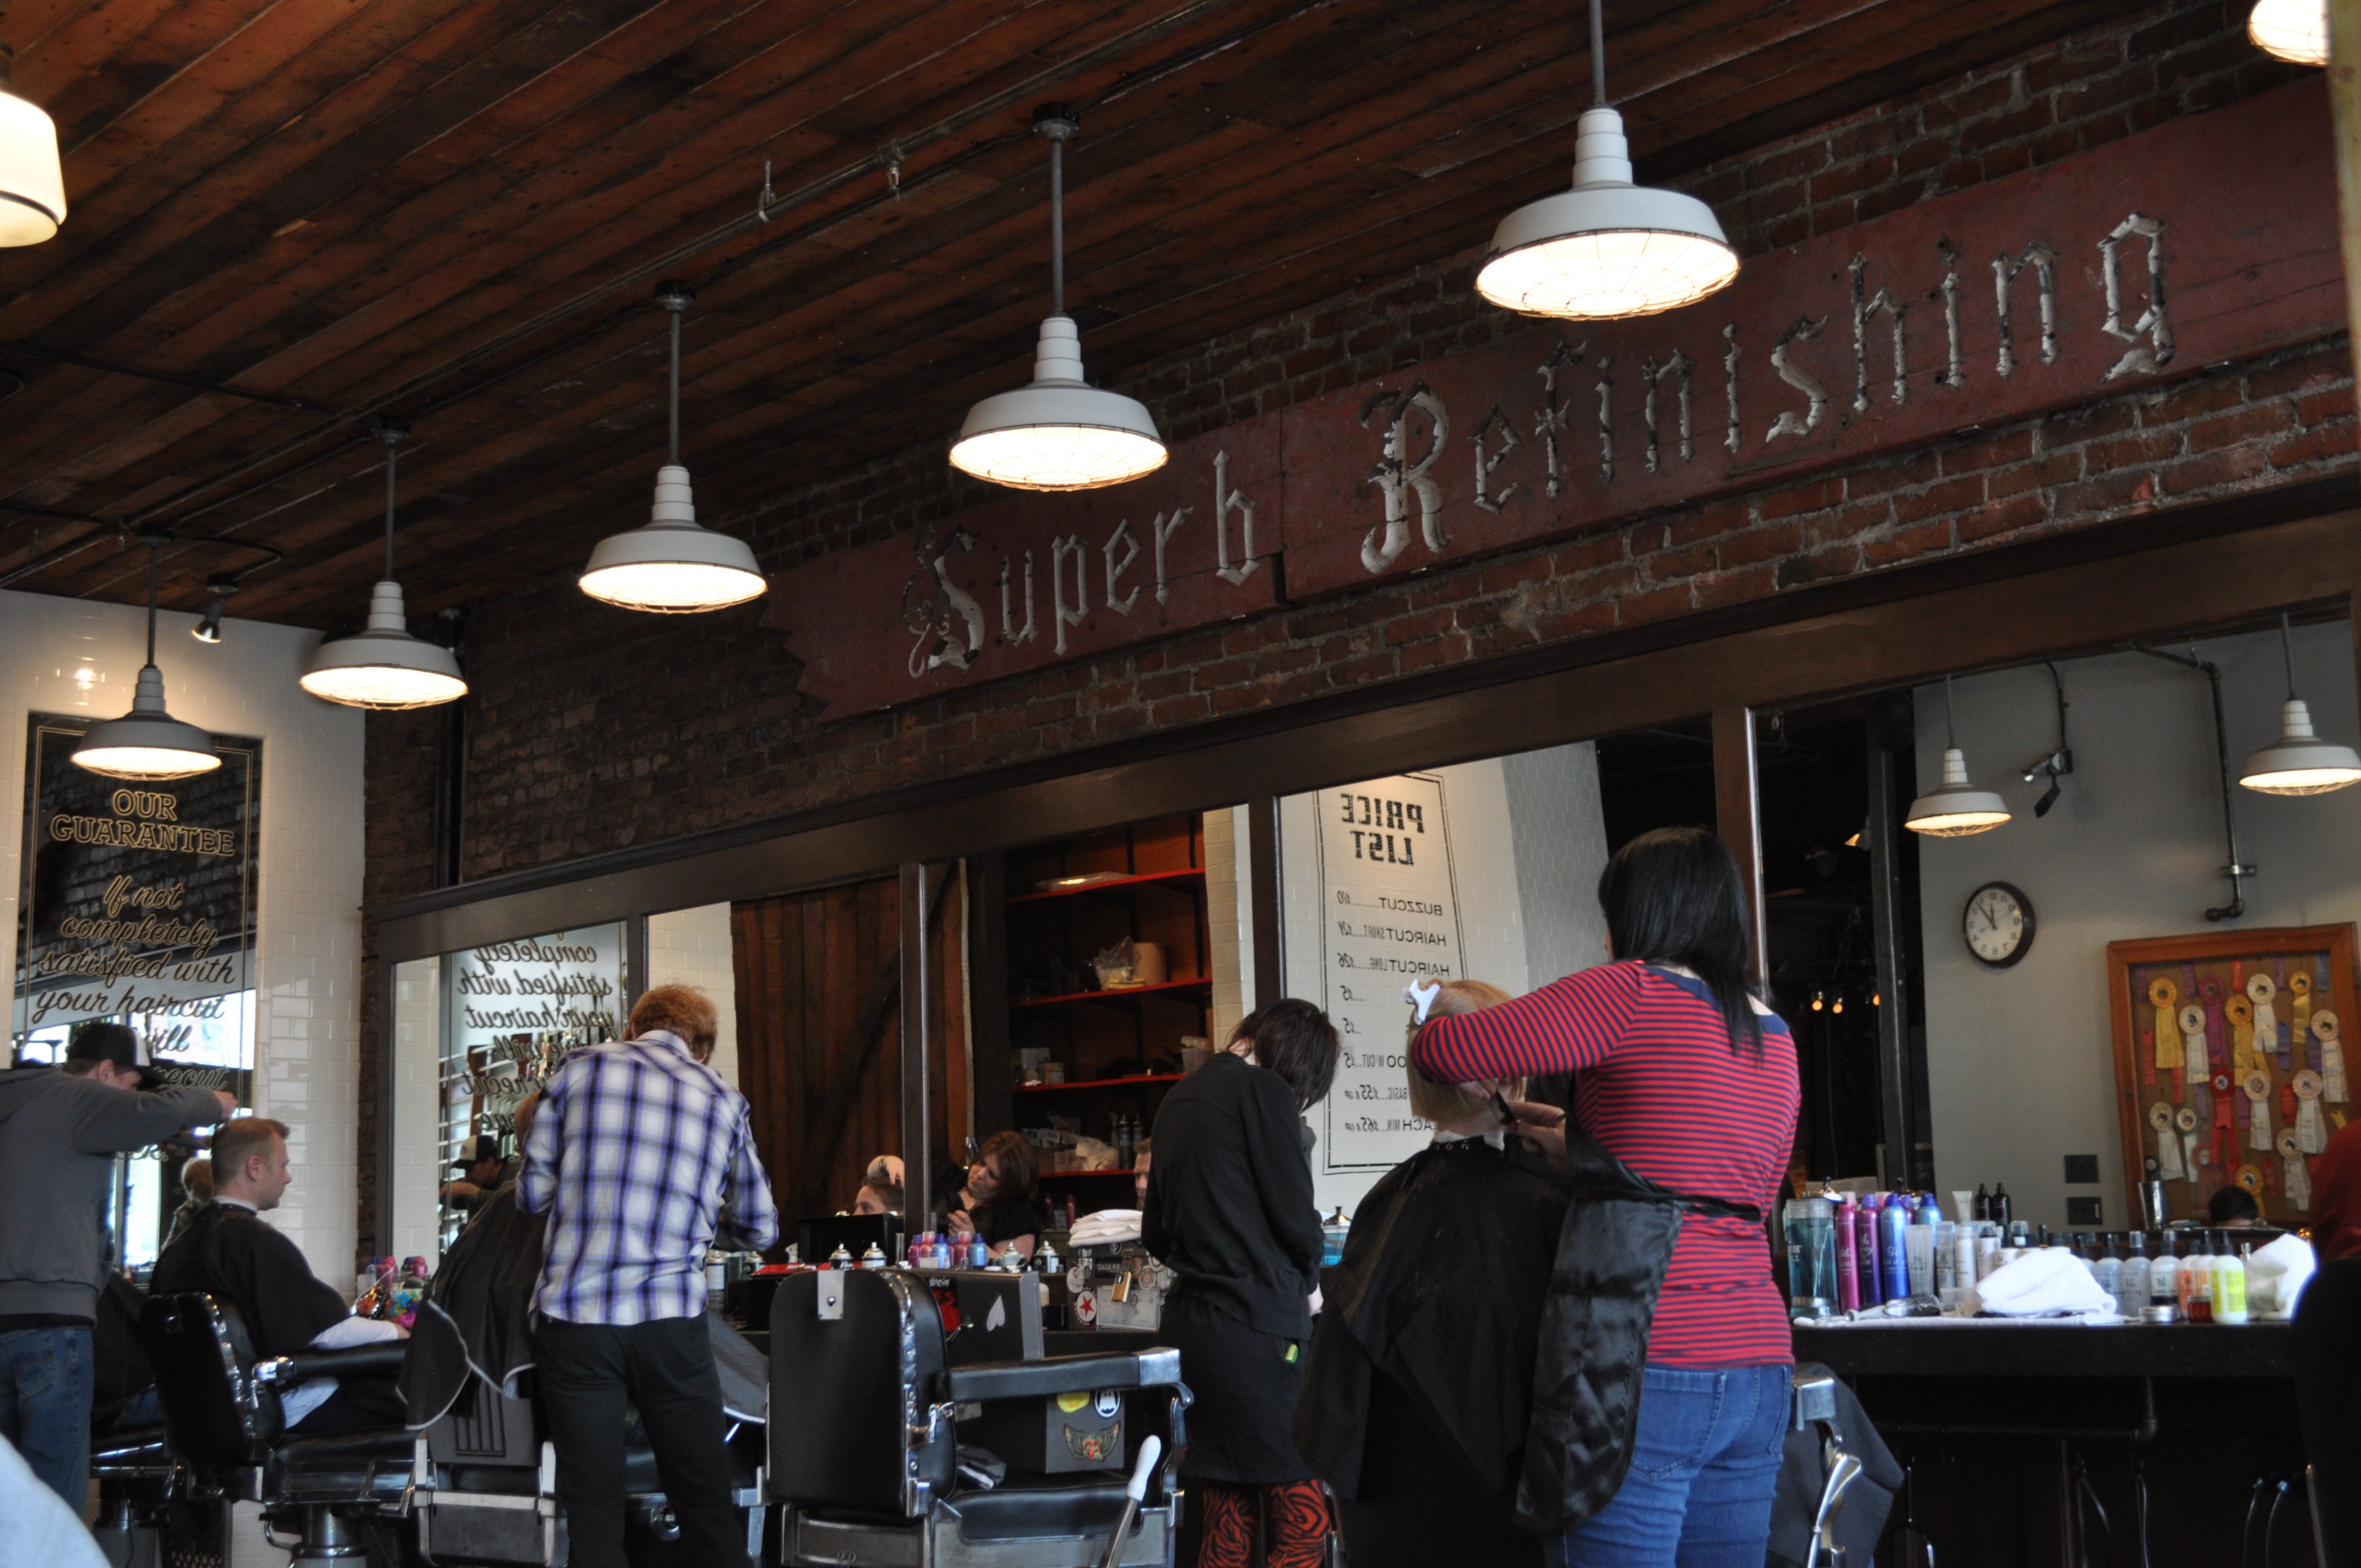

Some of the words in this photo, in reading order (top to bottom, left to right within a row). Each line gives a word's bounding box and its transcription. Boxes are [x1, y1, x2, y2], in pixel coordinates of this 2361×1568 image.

[901, 449, 1260, 679] Superb
[1357, 210, 2175, 575] Refinishing
[112, 789, 178, 821] OUR
[50, 815, 235, 857] GUARANTEE
[103, 874, 129, 917] If
[133, 884, 185, 911] not
[61, 916, 220, 959] completely
[39, 949, 168, 988] satisfied
[174, 955, 236, 984] with
[31, 988, 112, 1023] your
[115, 986, 226, 1020] haircut
